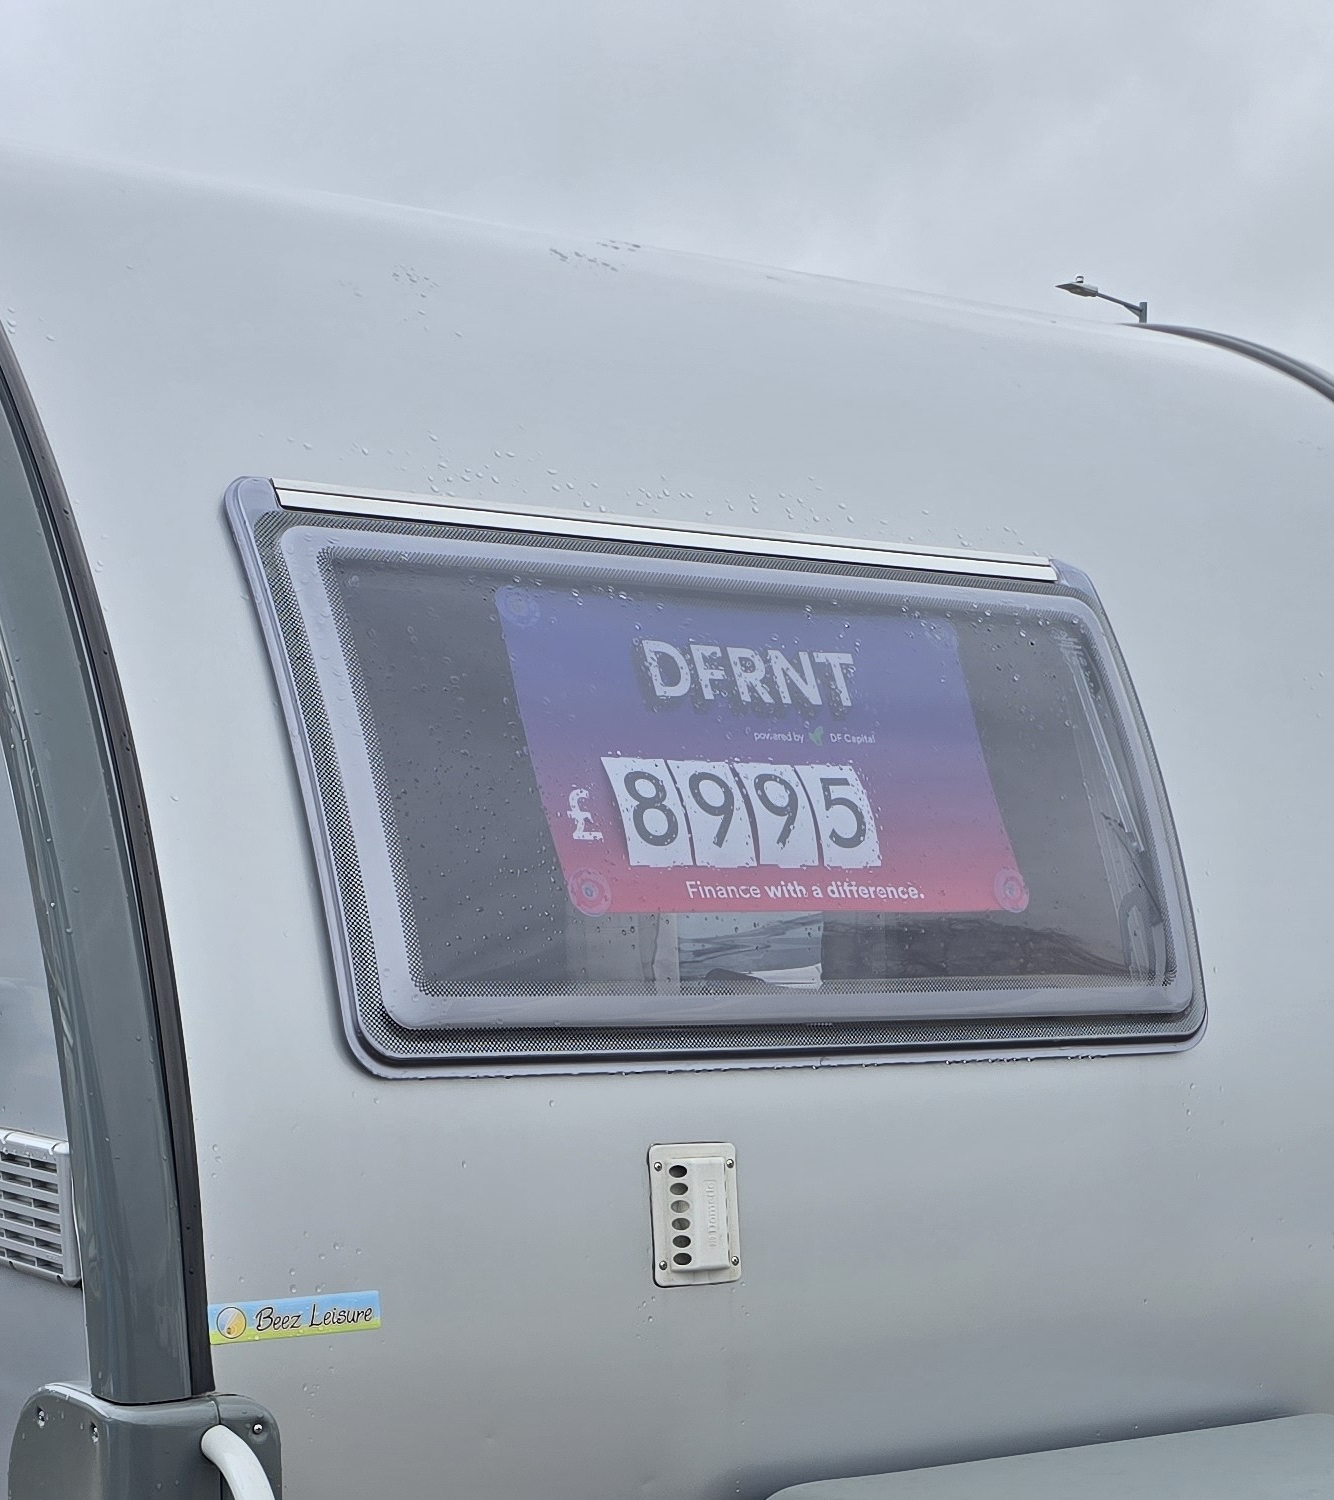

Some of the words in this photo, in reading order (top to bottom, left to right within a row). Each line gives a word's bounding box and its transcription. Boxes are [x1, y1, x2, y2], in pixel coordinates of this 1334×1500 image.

[641, 639, 855, 707] DFRNT
[753, 732, 792, 742] powered
[793, 732, 805, 743] by
[830, 733, 842, 743] DF
[844, 734, 876, 744] Capital
[567, 788, 604, 841] £
[623, 769, 867, 850] 8995
[685, 880, 761, 900] Finance
[764, 881, 807, 899] with
[812, 885, 823, 898] a
[826, 881, 925, 900] difference.
[255, 1306, 301, 1331] Beez
[309, 1304, 373, 1327] Leisure
